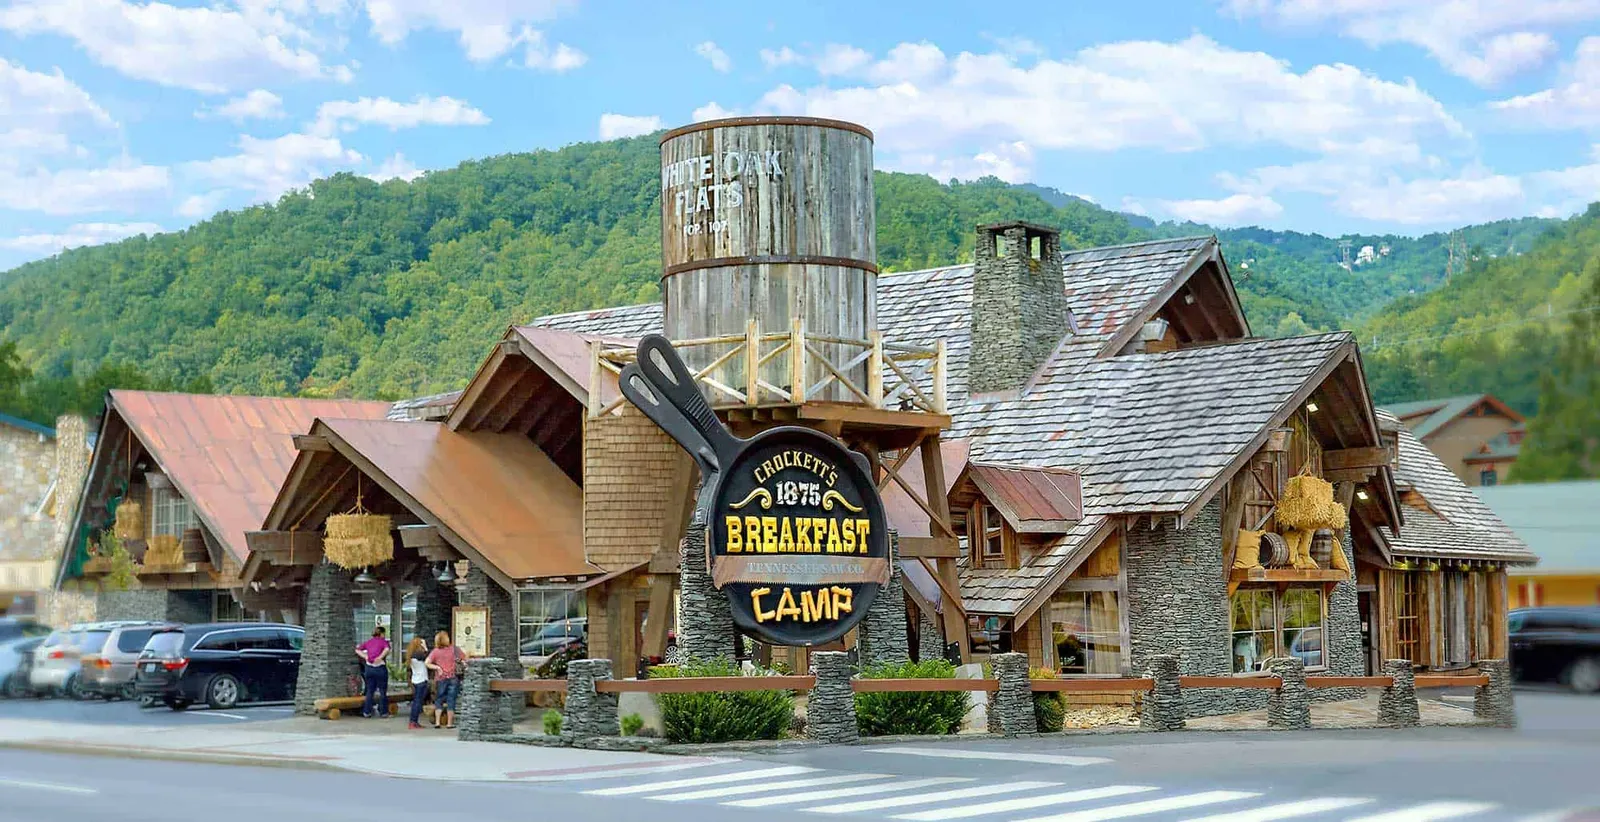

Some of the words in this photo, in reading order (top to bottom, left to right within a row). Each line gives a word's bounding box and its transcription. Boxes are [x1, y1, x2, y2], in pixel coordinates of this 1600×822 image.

[662, 156, 713, 192] WHITE
[723, 151, 783, 180] OAK
[675, 180, 744, 217] FLATS
[709, 220, 728, 234] 107
[754, 450, 839, 488] CROCKETT'S
[775, 480, 822, 507] 1875
[725, 515, 871, 554] BREAKFAST
[747, 562, 819, 575] TENNESSEE
[821, 563, 846, 574] SAW
[847, 563, 865, 574] CO.
[751, 586, 853, 623] CAMP
